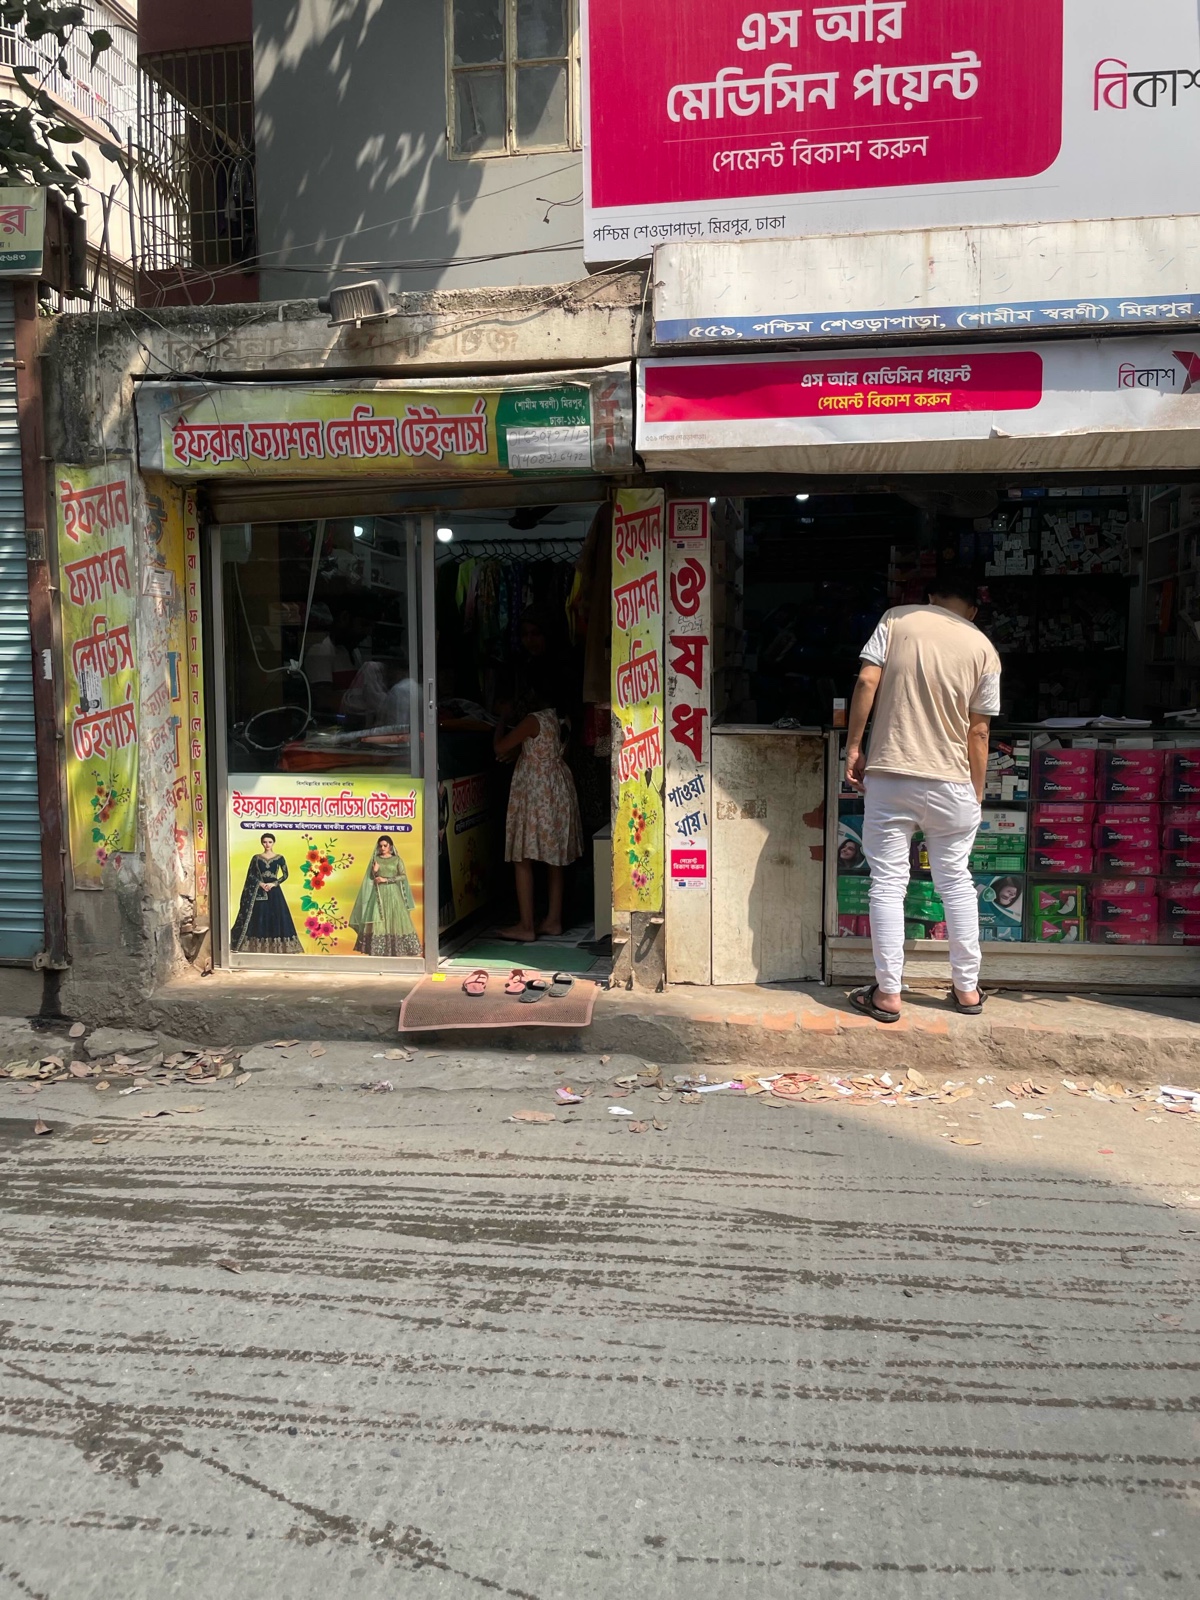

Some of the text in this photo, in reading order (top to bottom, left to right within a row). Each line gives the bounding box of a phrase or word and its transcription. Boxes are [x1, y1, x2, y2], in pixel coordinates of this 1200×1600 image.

[736, 7, 801, 52] এস
[666, 51, 982, 123] মেডিসিন পয়েন্ট
[711, 136, 929, 174] পেমেন্ট বিকাশ করুন
[592, 215, 786, 243] পশ্চিম শেওড়াপাড়া, মিরপুর, ঢাকা
[688, 301, 1194, 338] ৫৫৯, পশ্চিম শেওড়াপাড়া, (শামীম স্বরণী) মিরপুর
[801, 362, 972, 388] এস আর মেডিসিন পয়েন্ট
[1117, 362, 1176, 389] বিকাশ
[514, 397, 537, 413] (শামীম
[561, 396, 585, 410] মিরপুর,
[549, 415, 586, 425] ঢাকা-১২১৬
[817, 389, 951, 411] পেমেন্ট বিকাশ করুন
[172, 396, 487, 465] ইফরান ফ্যাশন লেডিস টেইলার্স
[59, 480, 130, 543] ইফরান
[614, 502, 662, 566] ইফরান
[64, 546, 131, 606] ফ্যাশন
[613, 570, 660, 630] ফ্যাশন
[72, 616, 134, 682] লেডিস
[616, 640, 661, 709] লেডিস
[73, 683, 138, 760] টেইলার্স
[232, 789, 417, 820] ইফরান ফ্যাশন লেডিস টেইলার্স
[668, 773, 705, 807] পাওয়া
